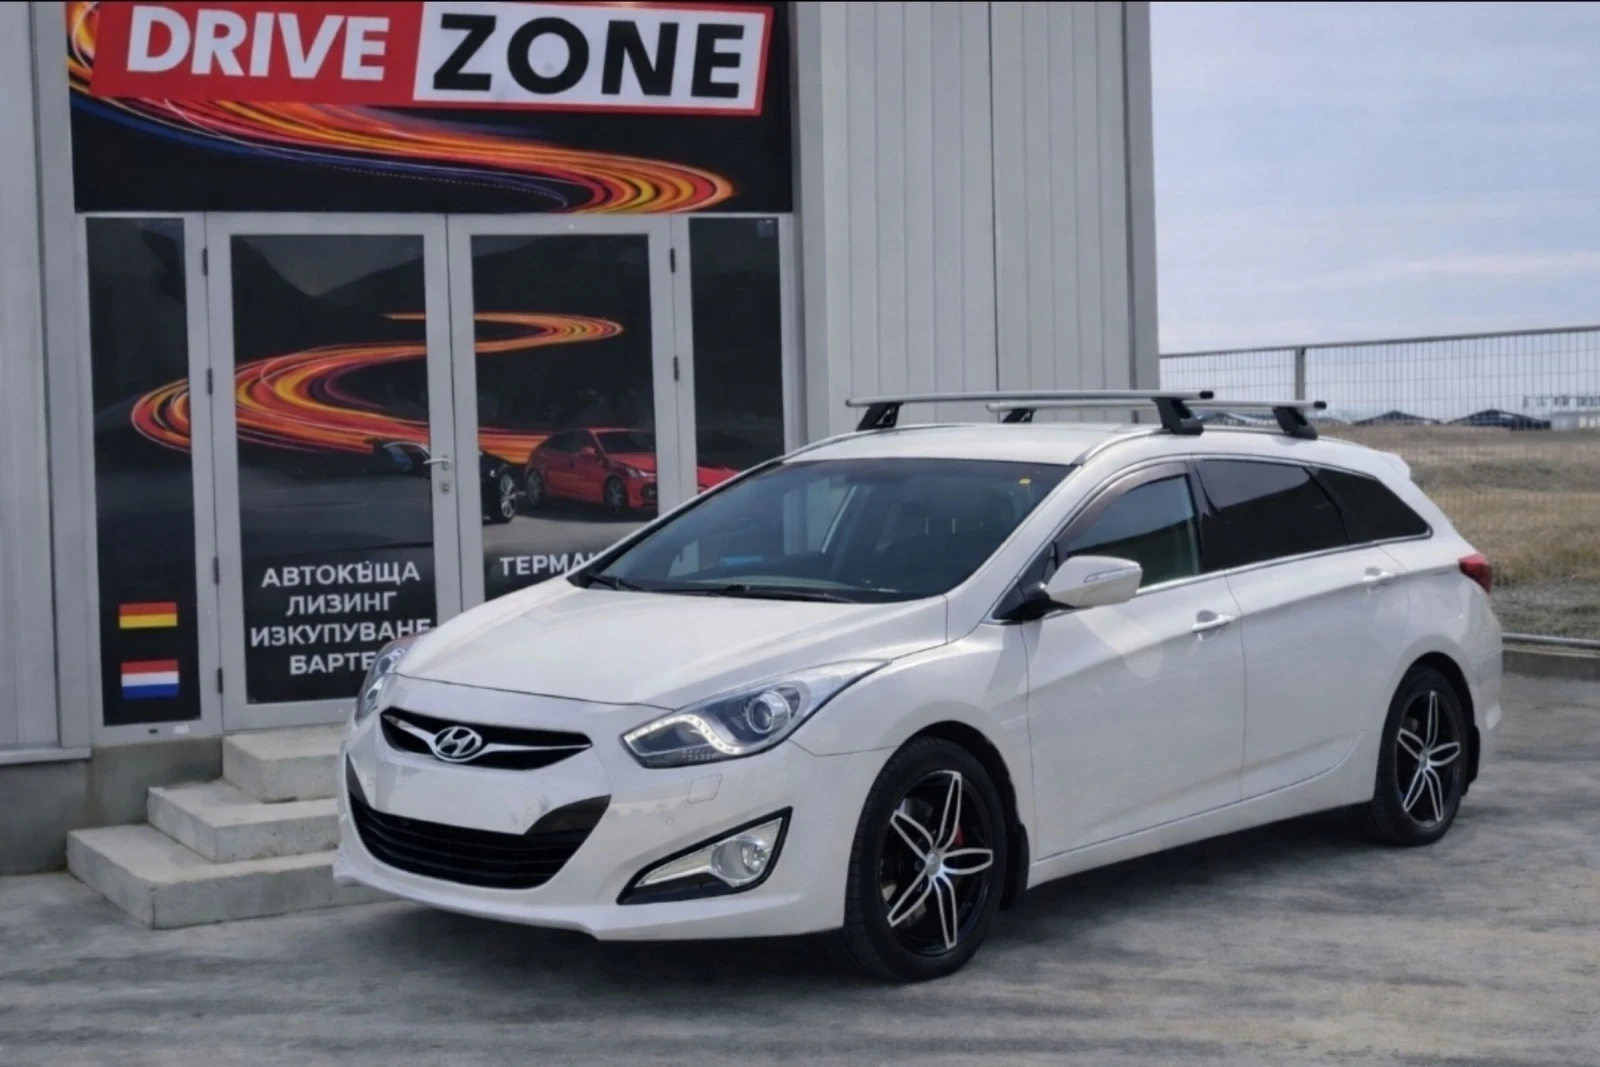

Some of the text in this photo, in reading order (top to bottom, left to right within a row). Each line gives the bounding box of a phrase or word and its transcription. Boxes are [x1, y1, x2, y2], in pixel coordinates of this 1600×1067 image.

[126, 5, 746, 99] DRIVE ZONE
[499, 552, 595, 576] ТЕРМА
[286, 591, 397, 616] ЛИЗИНГ
[250, 618, 431, 647] ИЗКУПУВАНЕ
